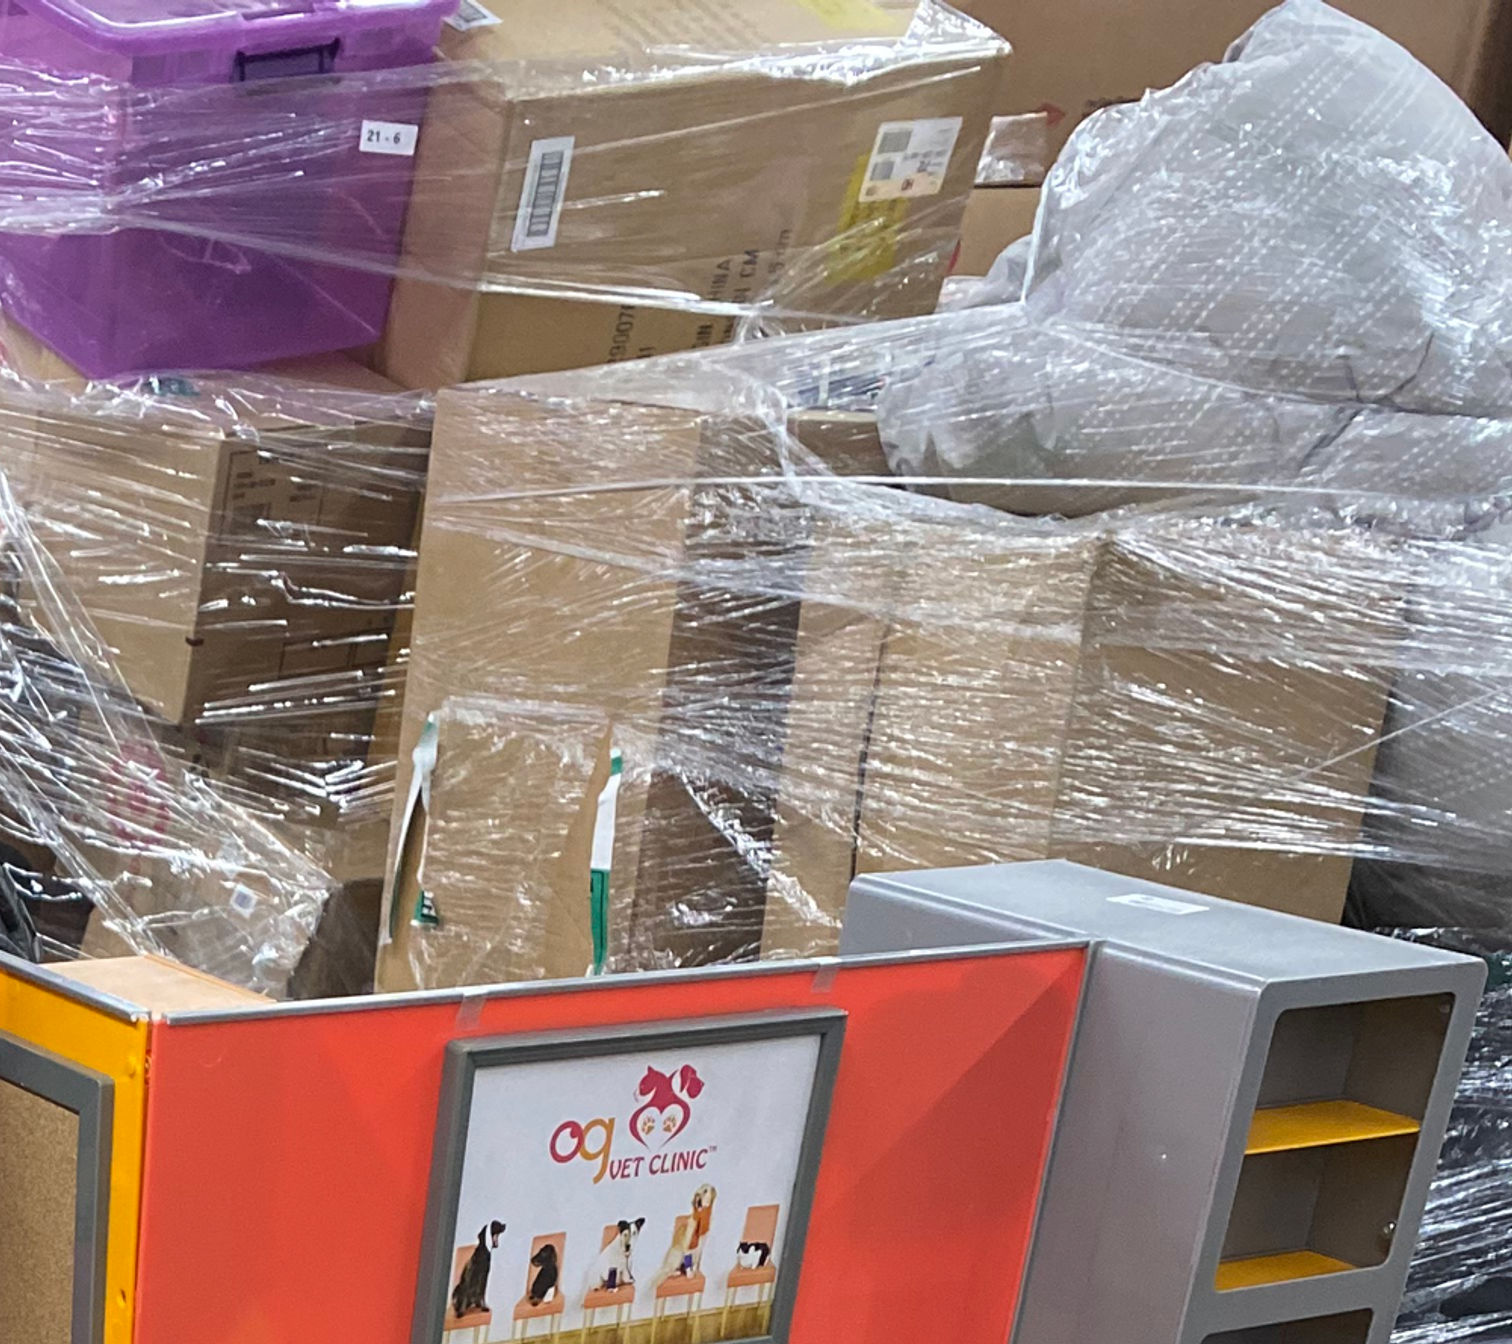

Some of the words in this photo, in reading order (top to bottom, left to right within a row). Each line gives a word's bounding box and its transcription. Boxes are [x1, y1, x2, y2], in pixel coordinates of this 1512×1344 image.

[366, 130, 381, 142] 21
[393, 132, 401, 144] 6
[610, 1156, 645, 1180] VET
